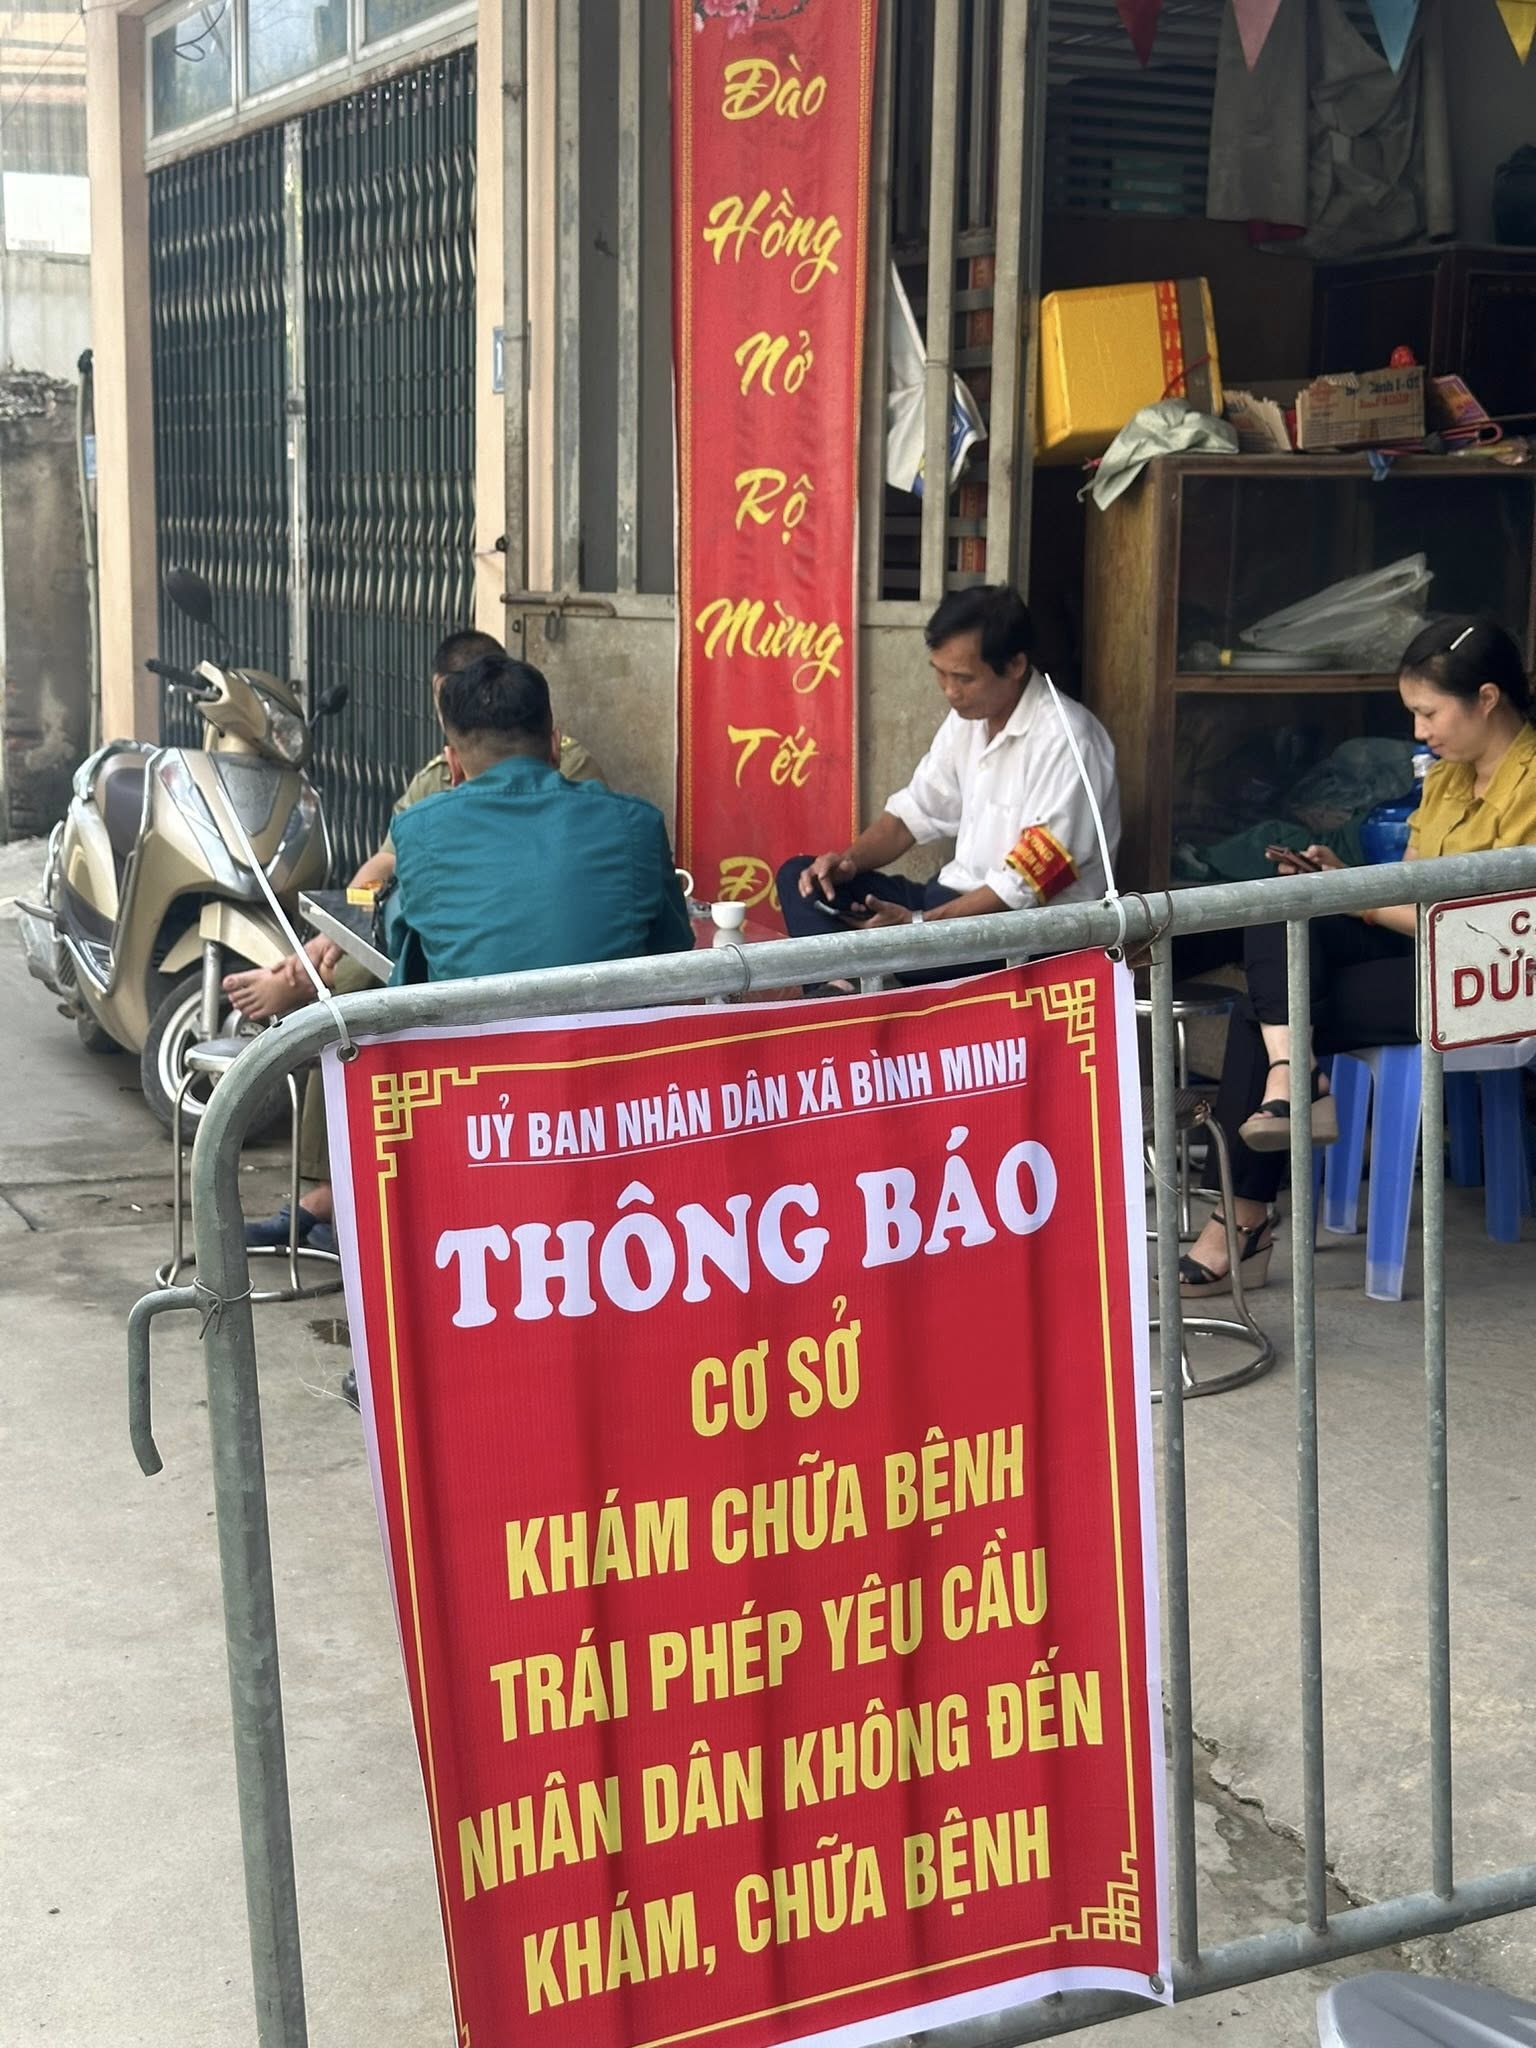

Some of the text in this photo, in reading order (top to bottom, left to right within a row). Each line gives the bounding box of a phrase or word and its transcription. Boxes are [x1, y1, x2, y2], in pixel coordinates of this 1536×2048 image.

[721, 53, 828, 121] Đào
[702, 187, 844, 294] Hồng
[733, 329, 815, 397] Nở
[734, 466, 814, 546] Rộ
[699, 597, 845, 695] Mừng
[727, 724, 819, 788] Tết
[467, 1037, 1027, 1160] UỶ BAN NHÂN DÂN XÃ BÌNH MINH
[435, 1126, 1057, 1328] THÔNG BÁO
[692, 1296, 861, 1436] CƠ SỞ
[506, 1424, 1023, 1600] KHÁM CHỮA BỆNH
[490, 1528, 1047, 1742] TRÁI PHÉP YÊU CẦU
[459, 1647, 1103, 1900] NHÂN DÂN KHÔNG ĐẾN
[524, 1806, 1050, 2014] KHÁM, CHỮA BỆNH
